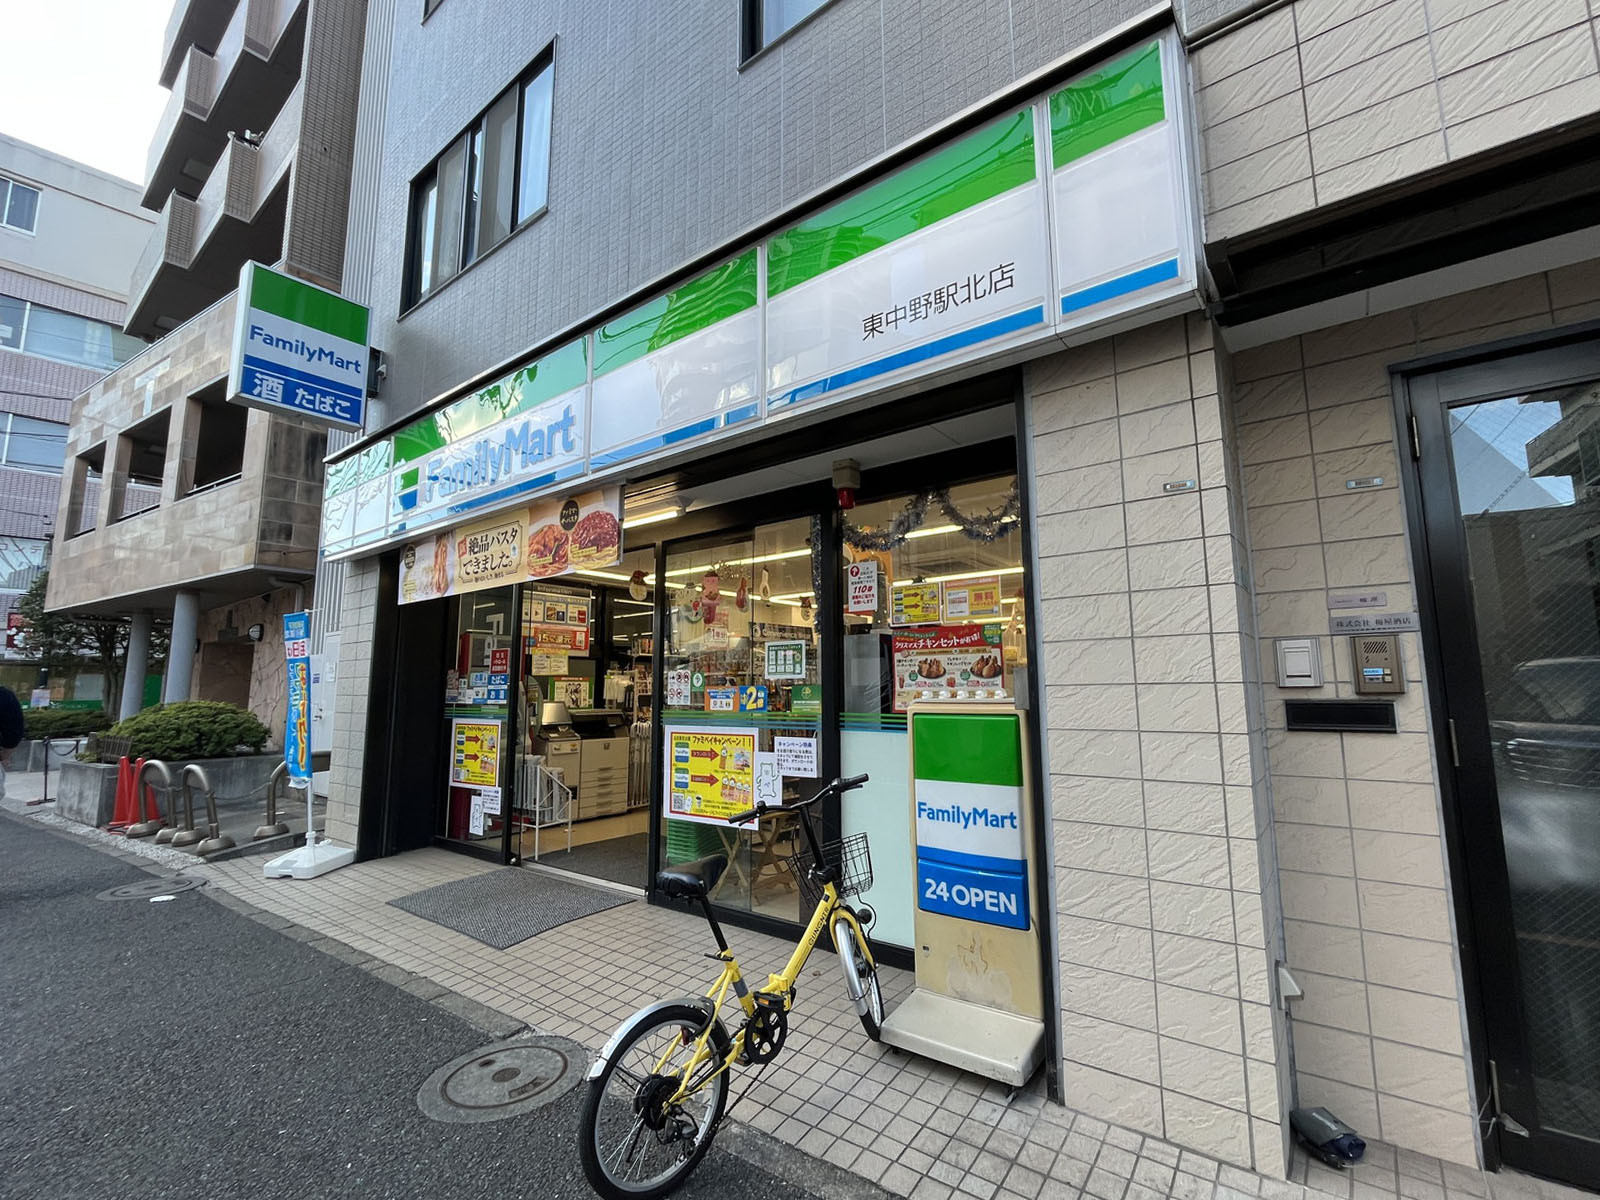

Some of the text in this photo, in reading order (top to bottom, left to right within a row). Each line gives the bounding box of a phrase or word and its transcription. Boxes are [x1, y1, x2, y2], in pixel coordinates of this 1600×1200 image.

[862, 262, 1015, 341] 東中野駅北店
[249, 324, 362, 374] FamilyMart
[252, 372, 351, 419] 酒 たばこ
[426, 403, 577, 504] FamilyMart
[468, 527, 518, 557] 絶品パスタ
[463, 551, 513, 576] できました。
[917, 801, 1018, 830] FamilyMart
[951, 884, 1018, 916] OPEN
[807, 906, 829, 946] GUNGNIR
